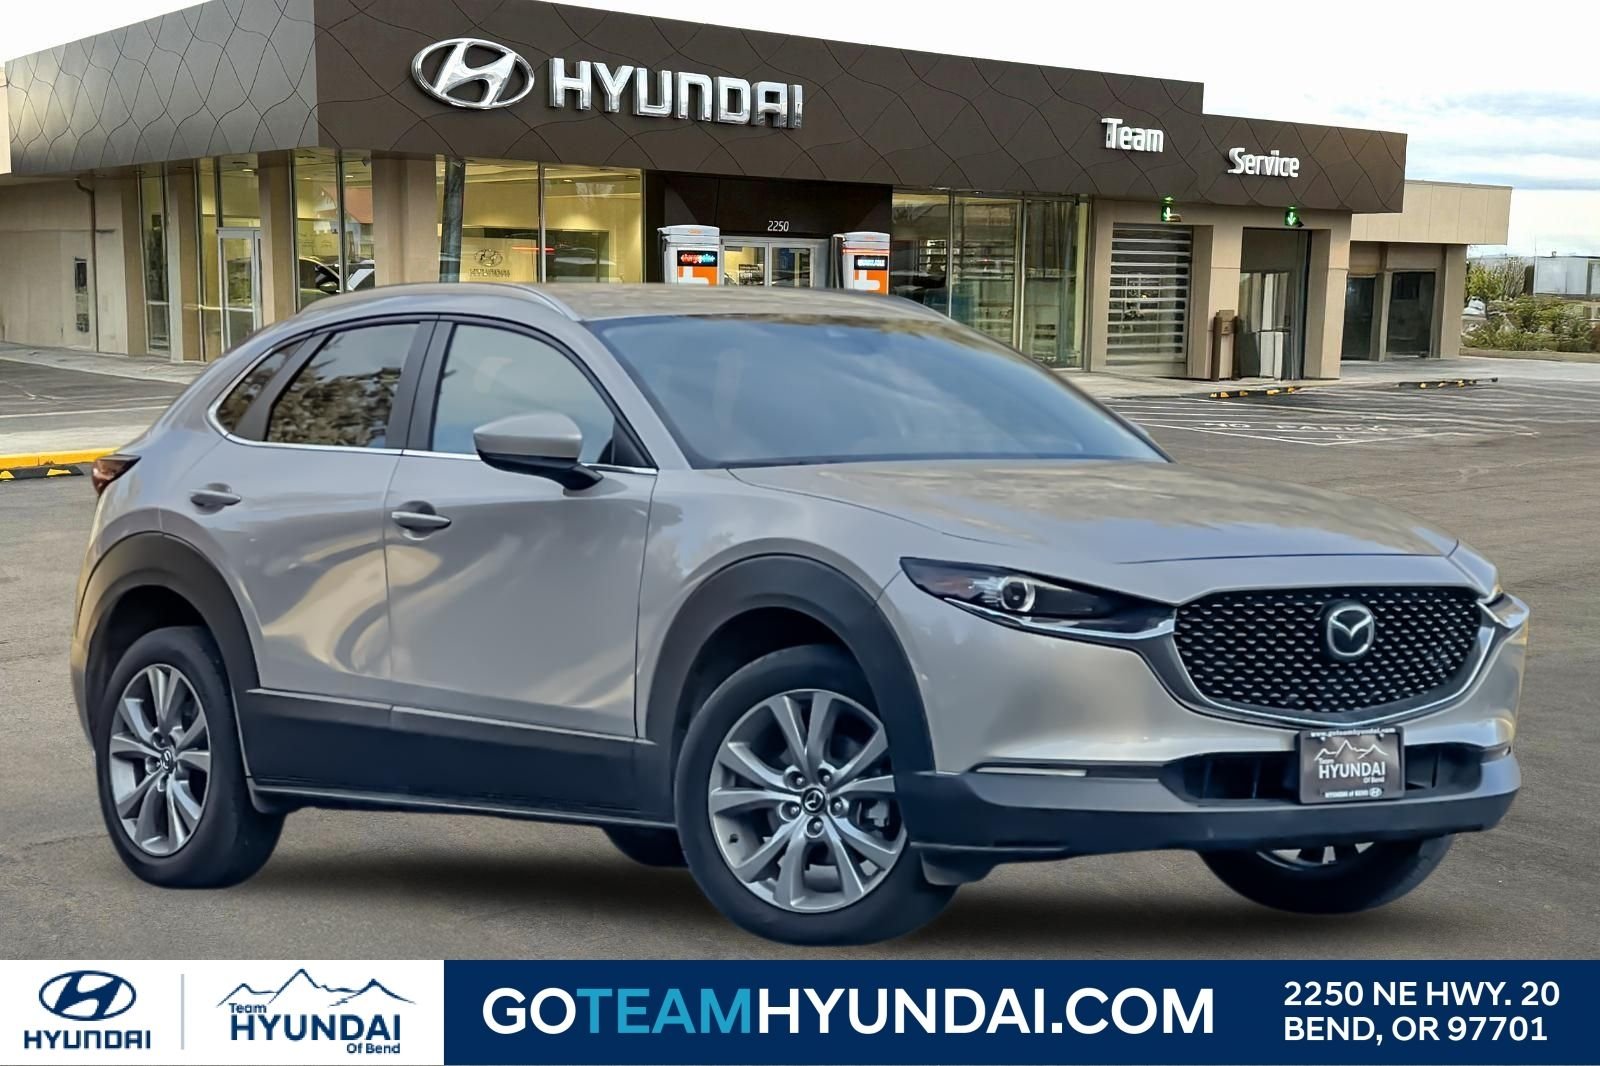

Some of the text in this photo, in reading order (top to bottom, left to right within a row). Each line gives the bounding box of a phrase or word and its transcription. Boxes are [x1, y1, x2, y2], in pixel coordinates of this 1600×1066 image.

[549, 57, 804, 129] HYUNDAI
[1101, 117, 1164, 153] Team
[1227, 146, 1301, 179] Service
[767, 220, 790, 232] 2250
[1318, 761, 1386, 779] HYUNDAI
